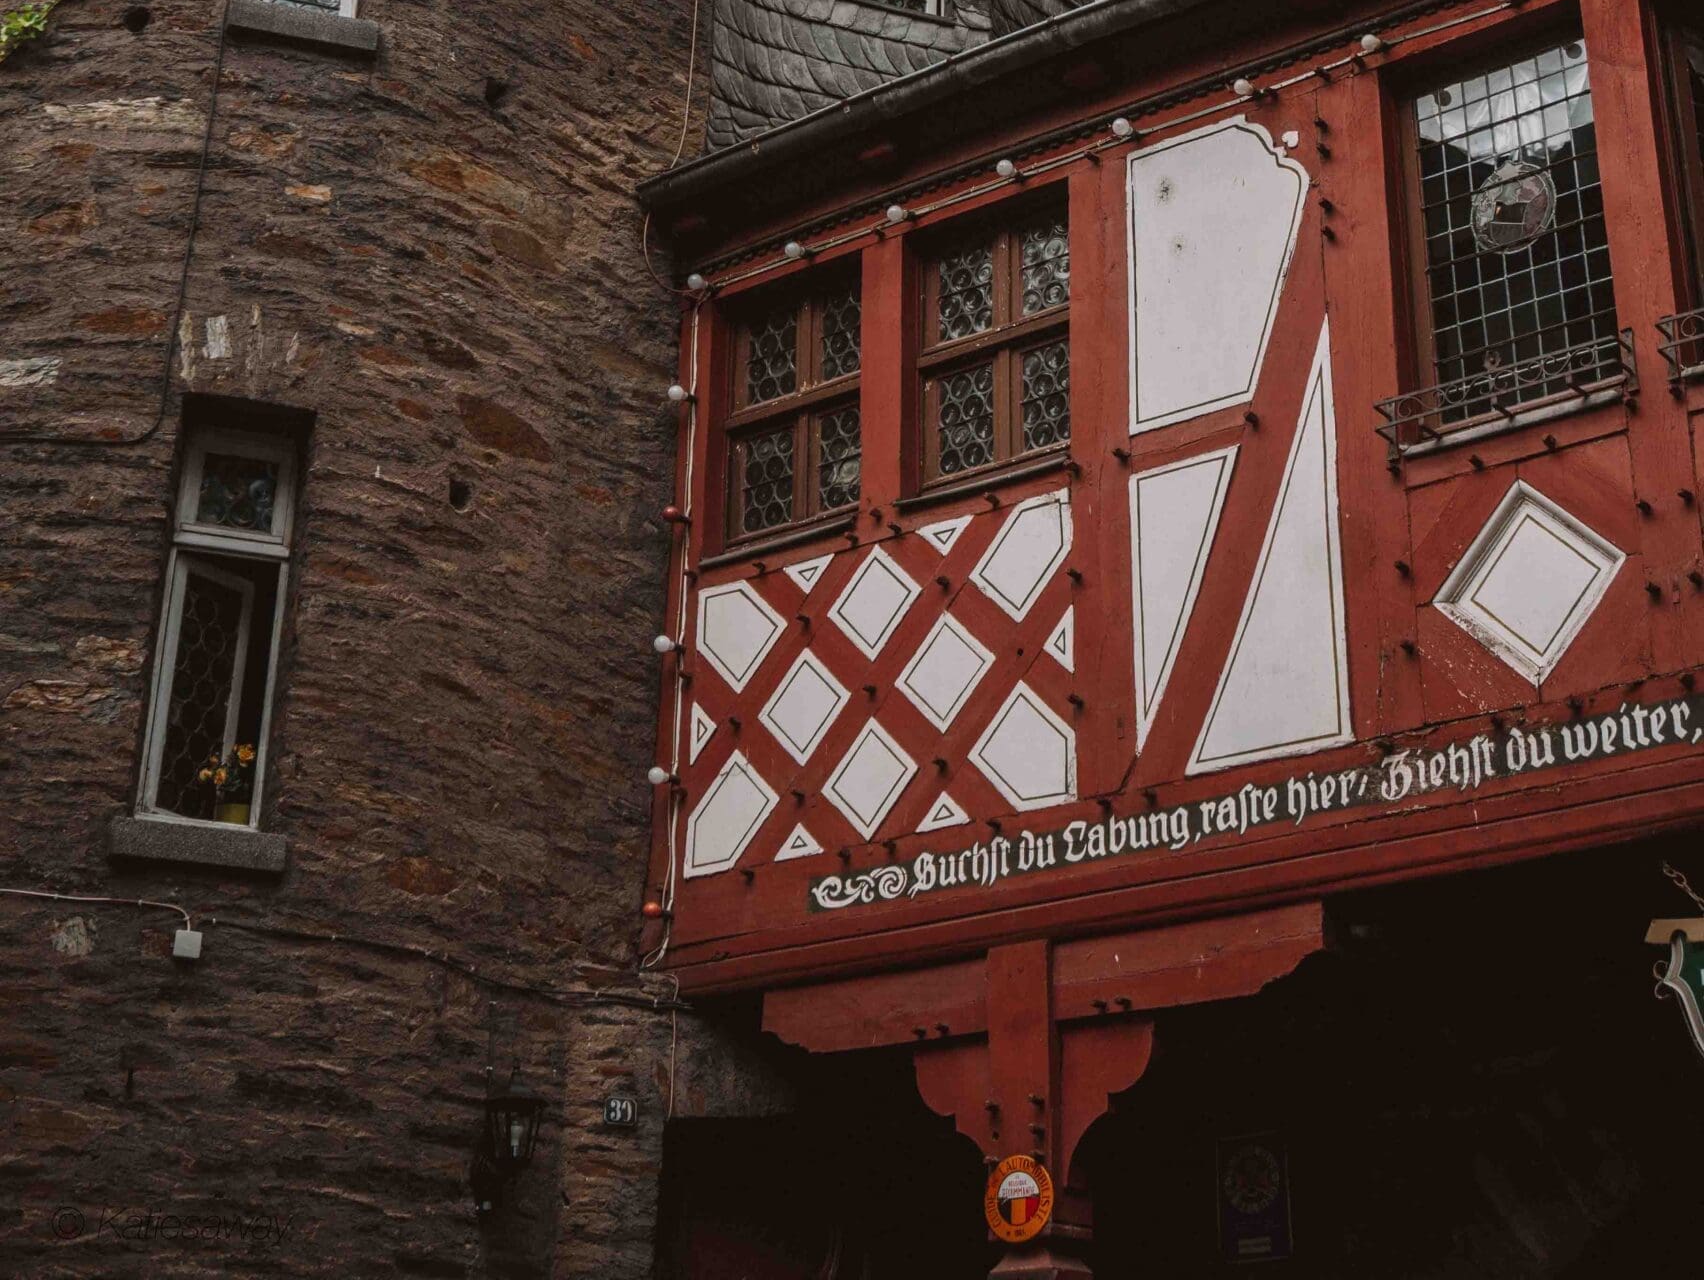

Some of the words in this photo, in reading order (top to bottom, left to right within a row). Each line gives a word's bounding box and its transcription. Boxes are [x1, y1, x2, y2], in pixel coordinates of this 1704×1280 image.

[1017, 829, 1057, 871] du
[1506, 726, 1556, 771] du
[1560, 701, 1702, 761] weiter,
